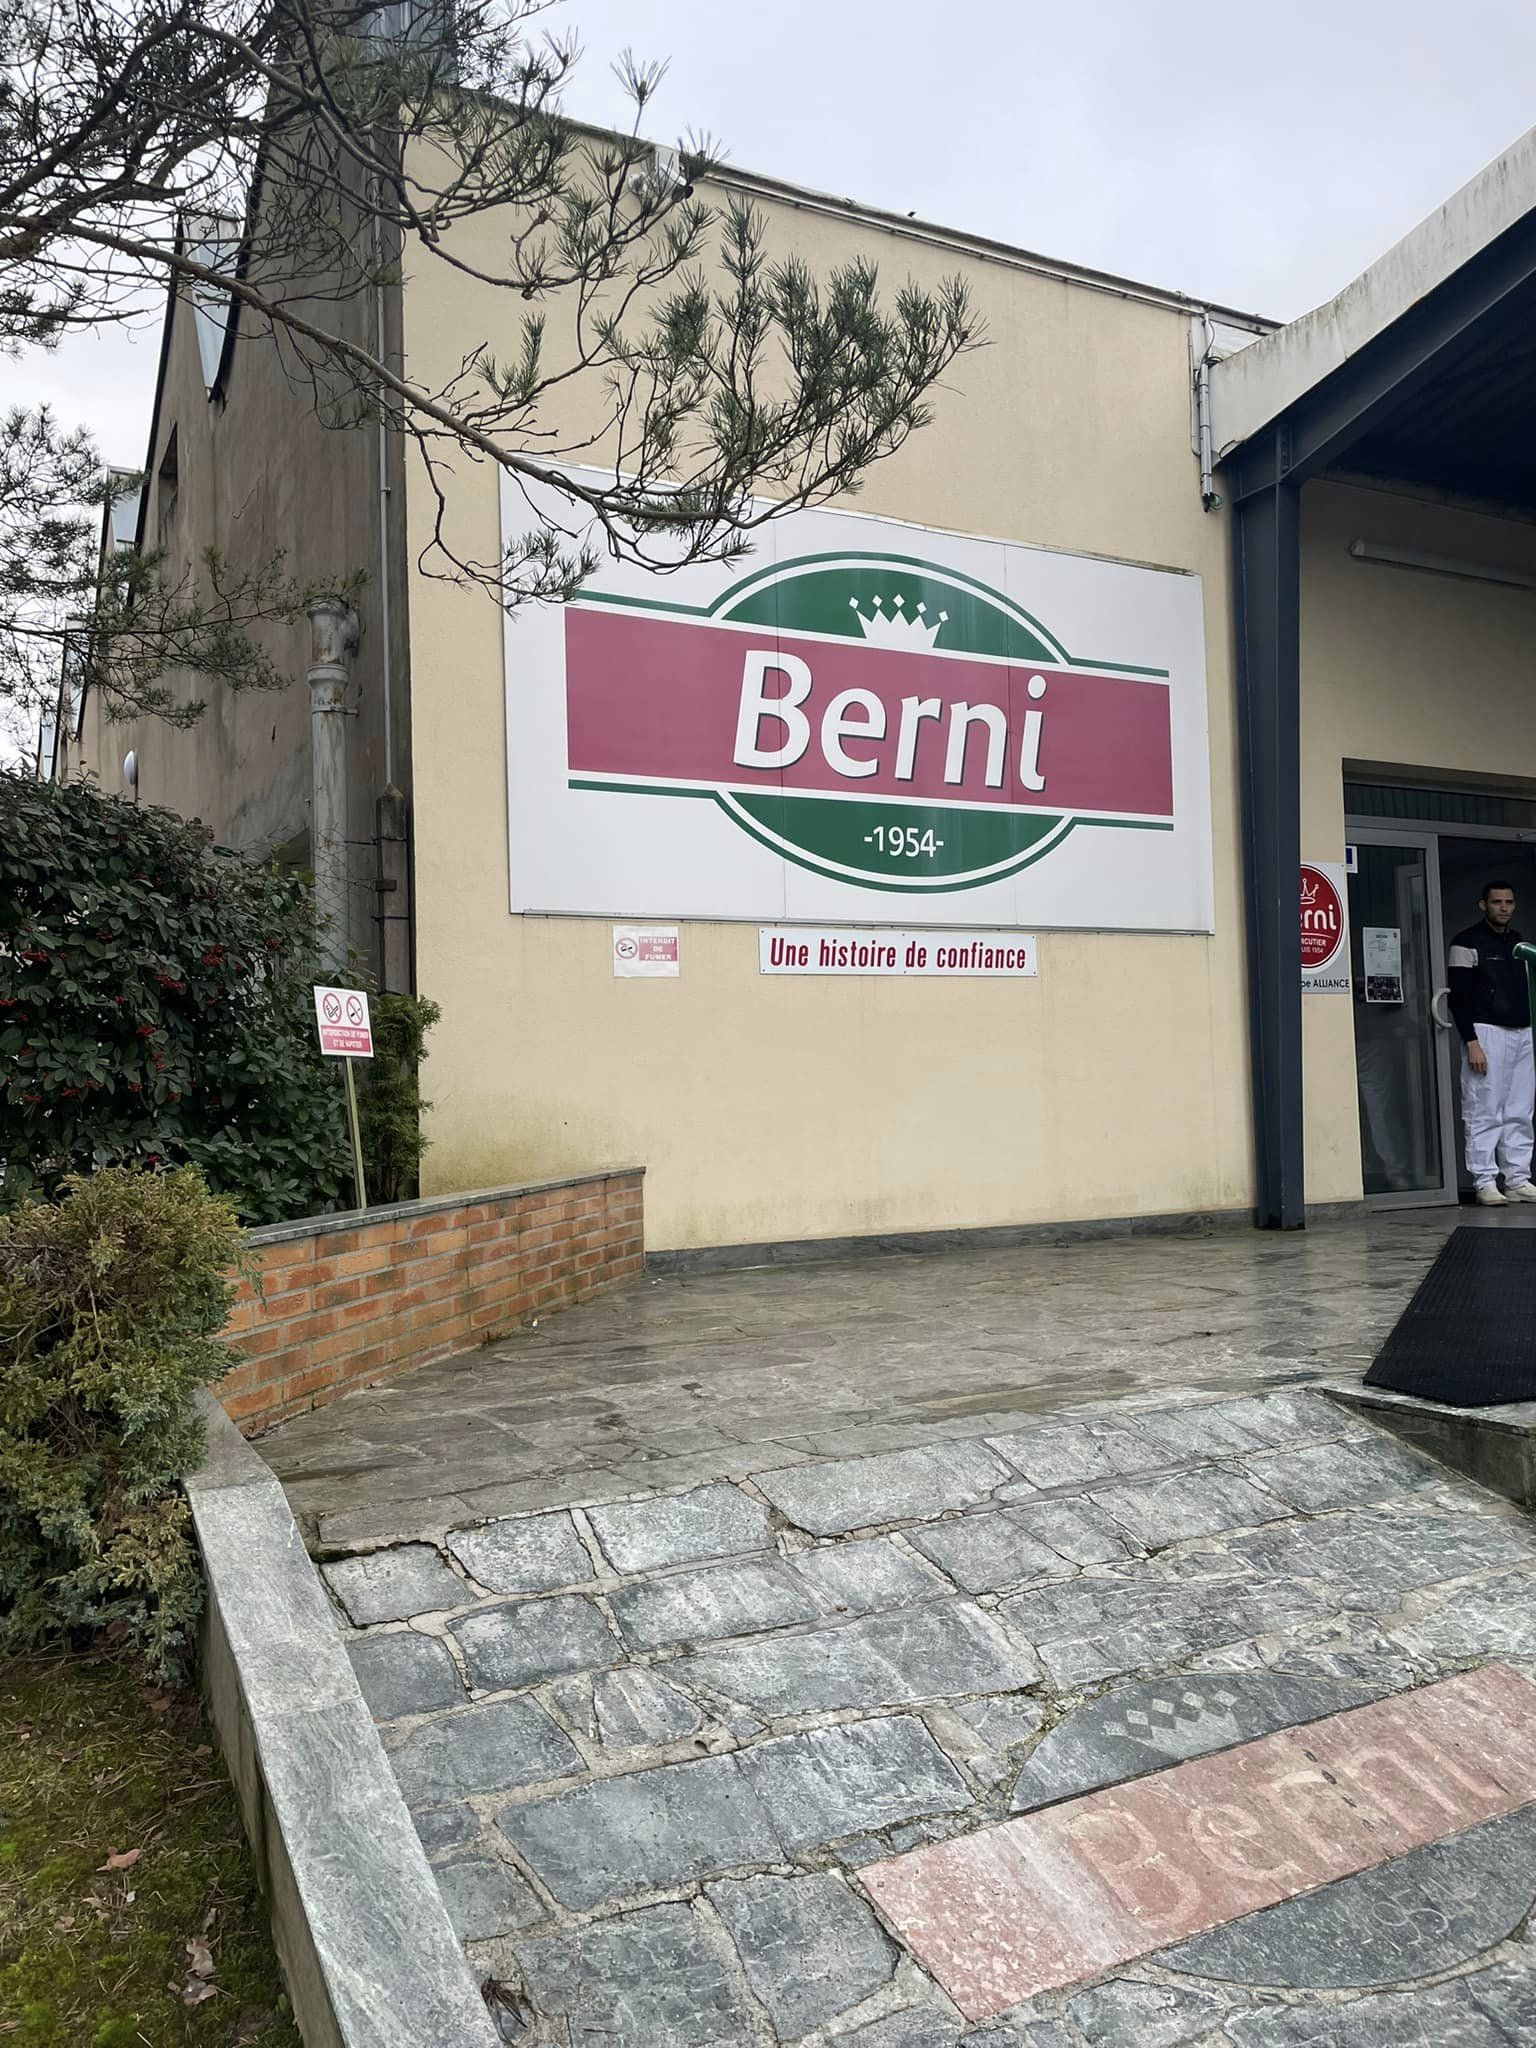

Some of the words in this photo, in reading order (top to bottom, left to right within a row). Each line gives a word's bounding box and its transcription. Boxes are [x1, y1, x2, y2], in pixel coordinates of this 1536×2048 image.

[733, 649, 1047, 791] Berni
[1300, 904, 1337, 930] rni
[770, 937, 809, 966] Une
[819, 938, 896, 968] histoire
[905, 940, 927, 968] de
[936, 942, 1026, 969] confiance
[1313, 978, 1349, 988] ALLIANCE
[1063, 1714, 1502, 1930] Berni
